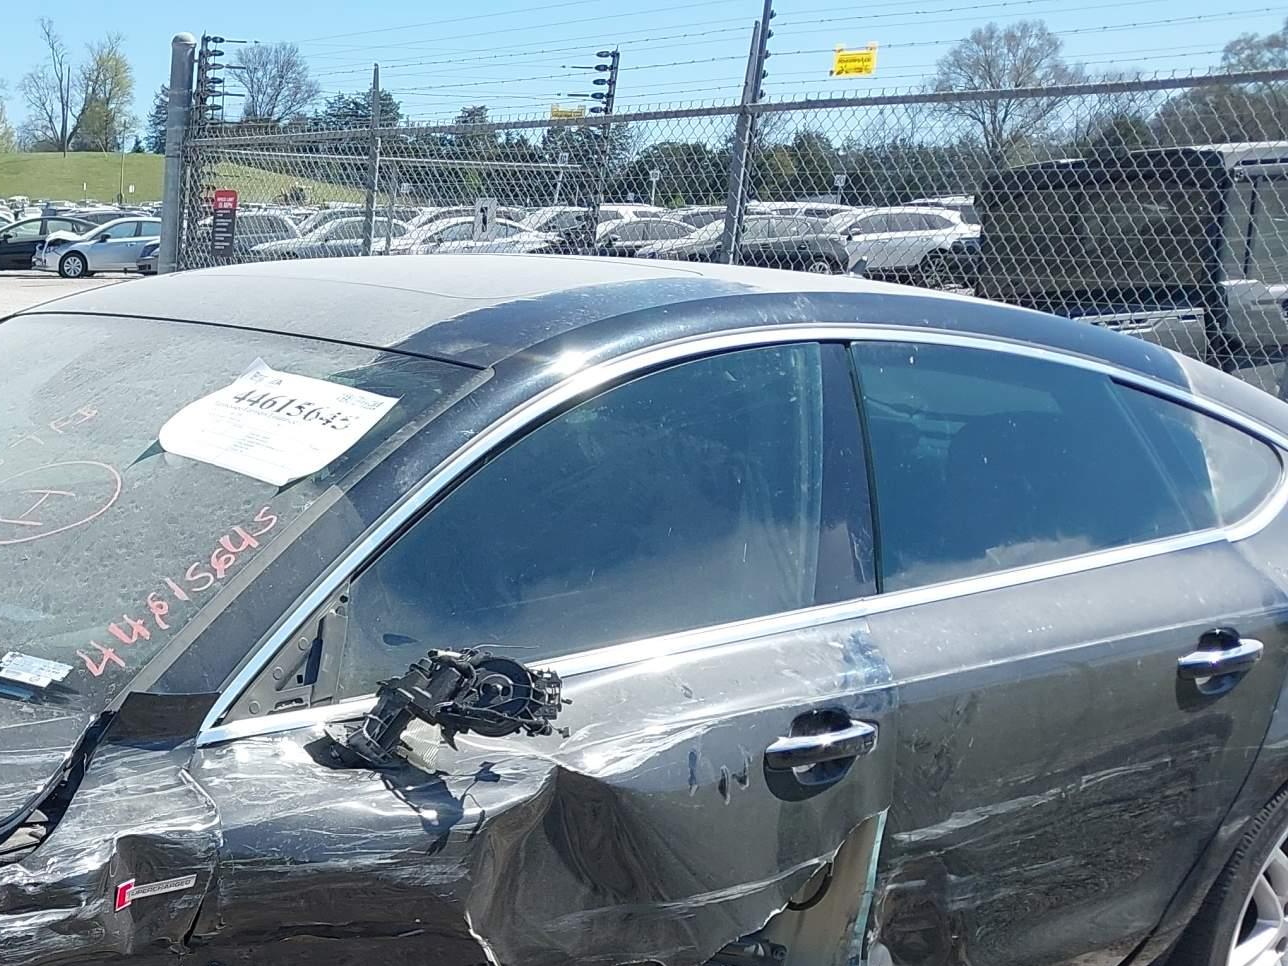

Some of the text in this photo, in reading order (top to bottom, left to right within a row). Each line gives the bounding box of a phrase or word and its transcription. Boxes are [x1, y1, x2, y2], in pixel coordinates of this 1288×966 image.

[480, 206, 488, 233] 1
[233, 389, 352, 431] 44615645
[76, 505, 279, 678] 44615645
